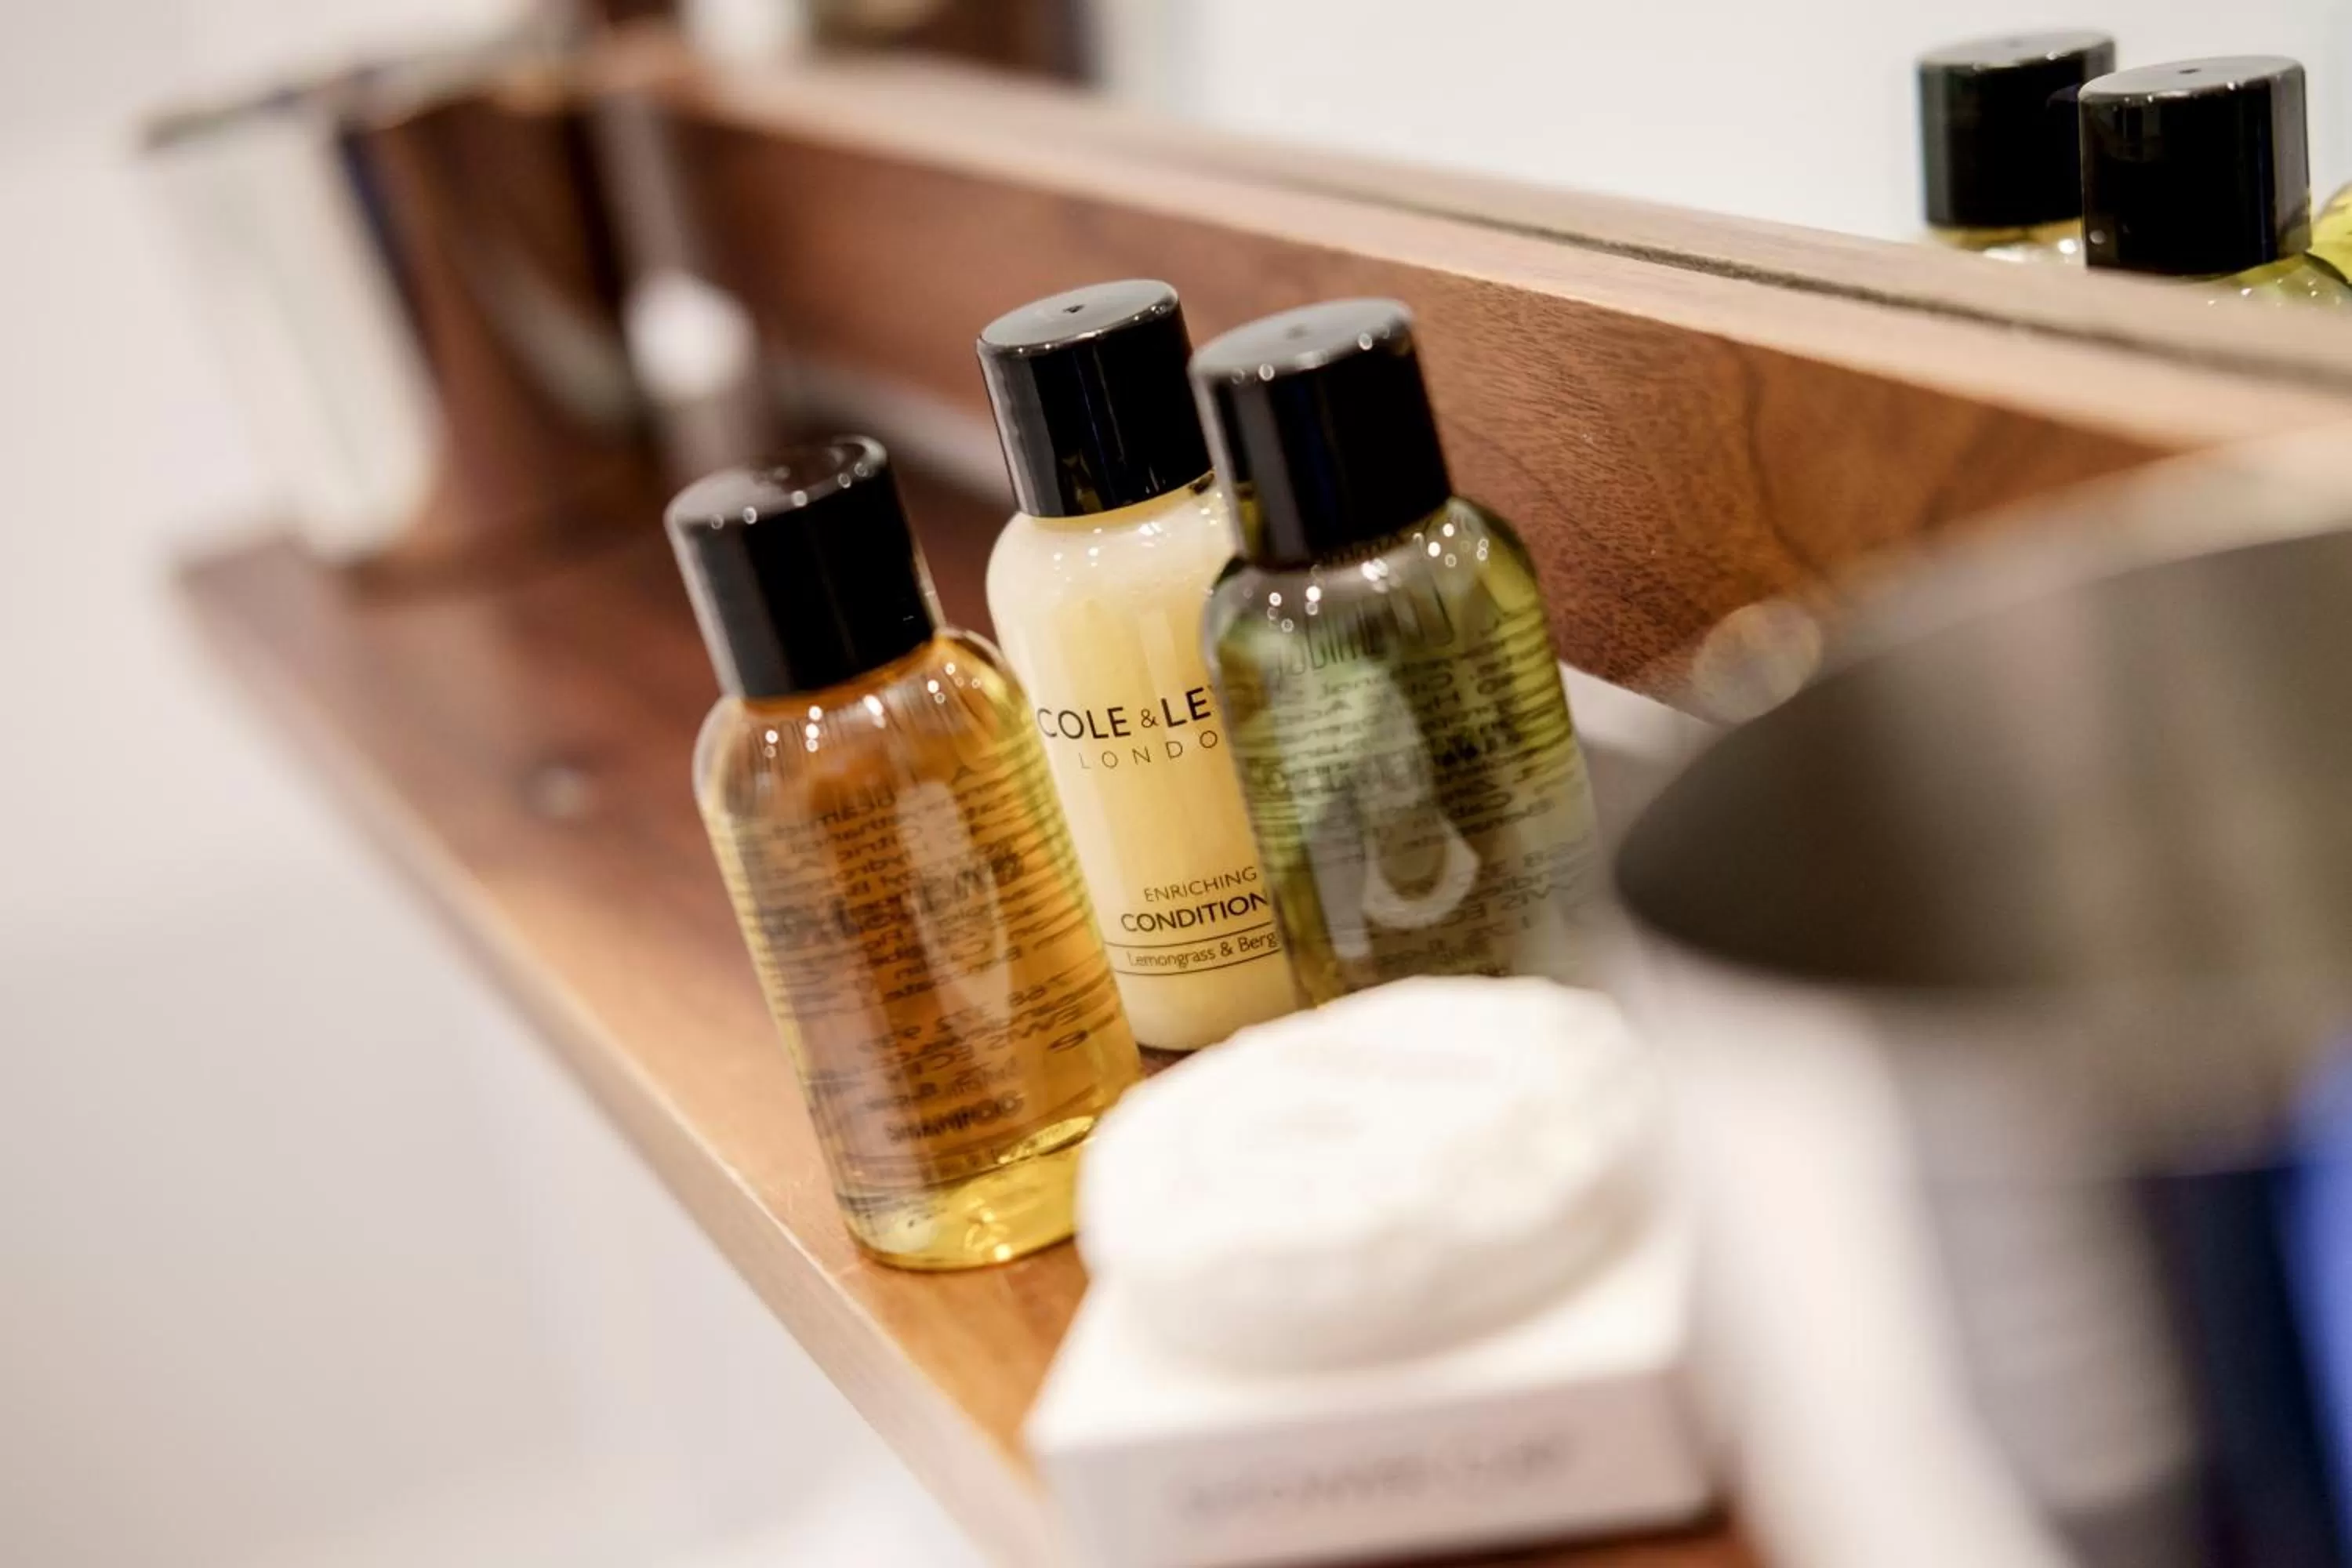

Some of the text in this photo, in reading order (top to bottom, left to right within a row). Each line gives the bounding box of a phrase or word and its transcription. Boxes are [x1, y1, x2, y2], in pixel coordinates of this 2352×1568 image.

[1036, 685, 1213, 739] COLE & LE
[1078, 730, 1218, 769] LONDO
[1144, 866, 1258, 902] ENRICHING
[1120, 891, 1269, 933] CONDITION
[1127, 932, 1278, 969] Lemongrass & Berg
